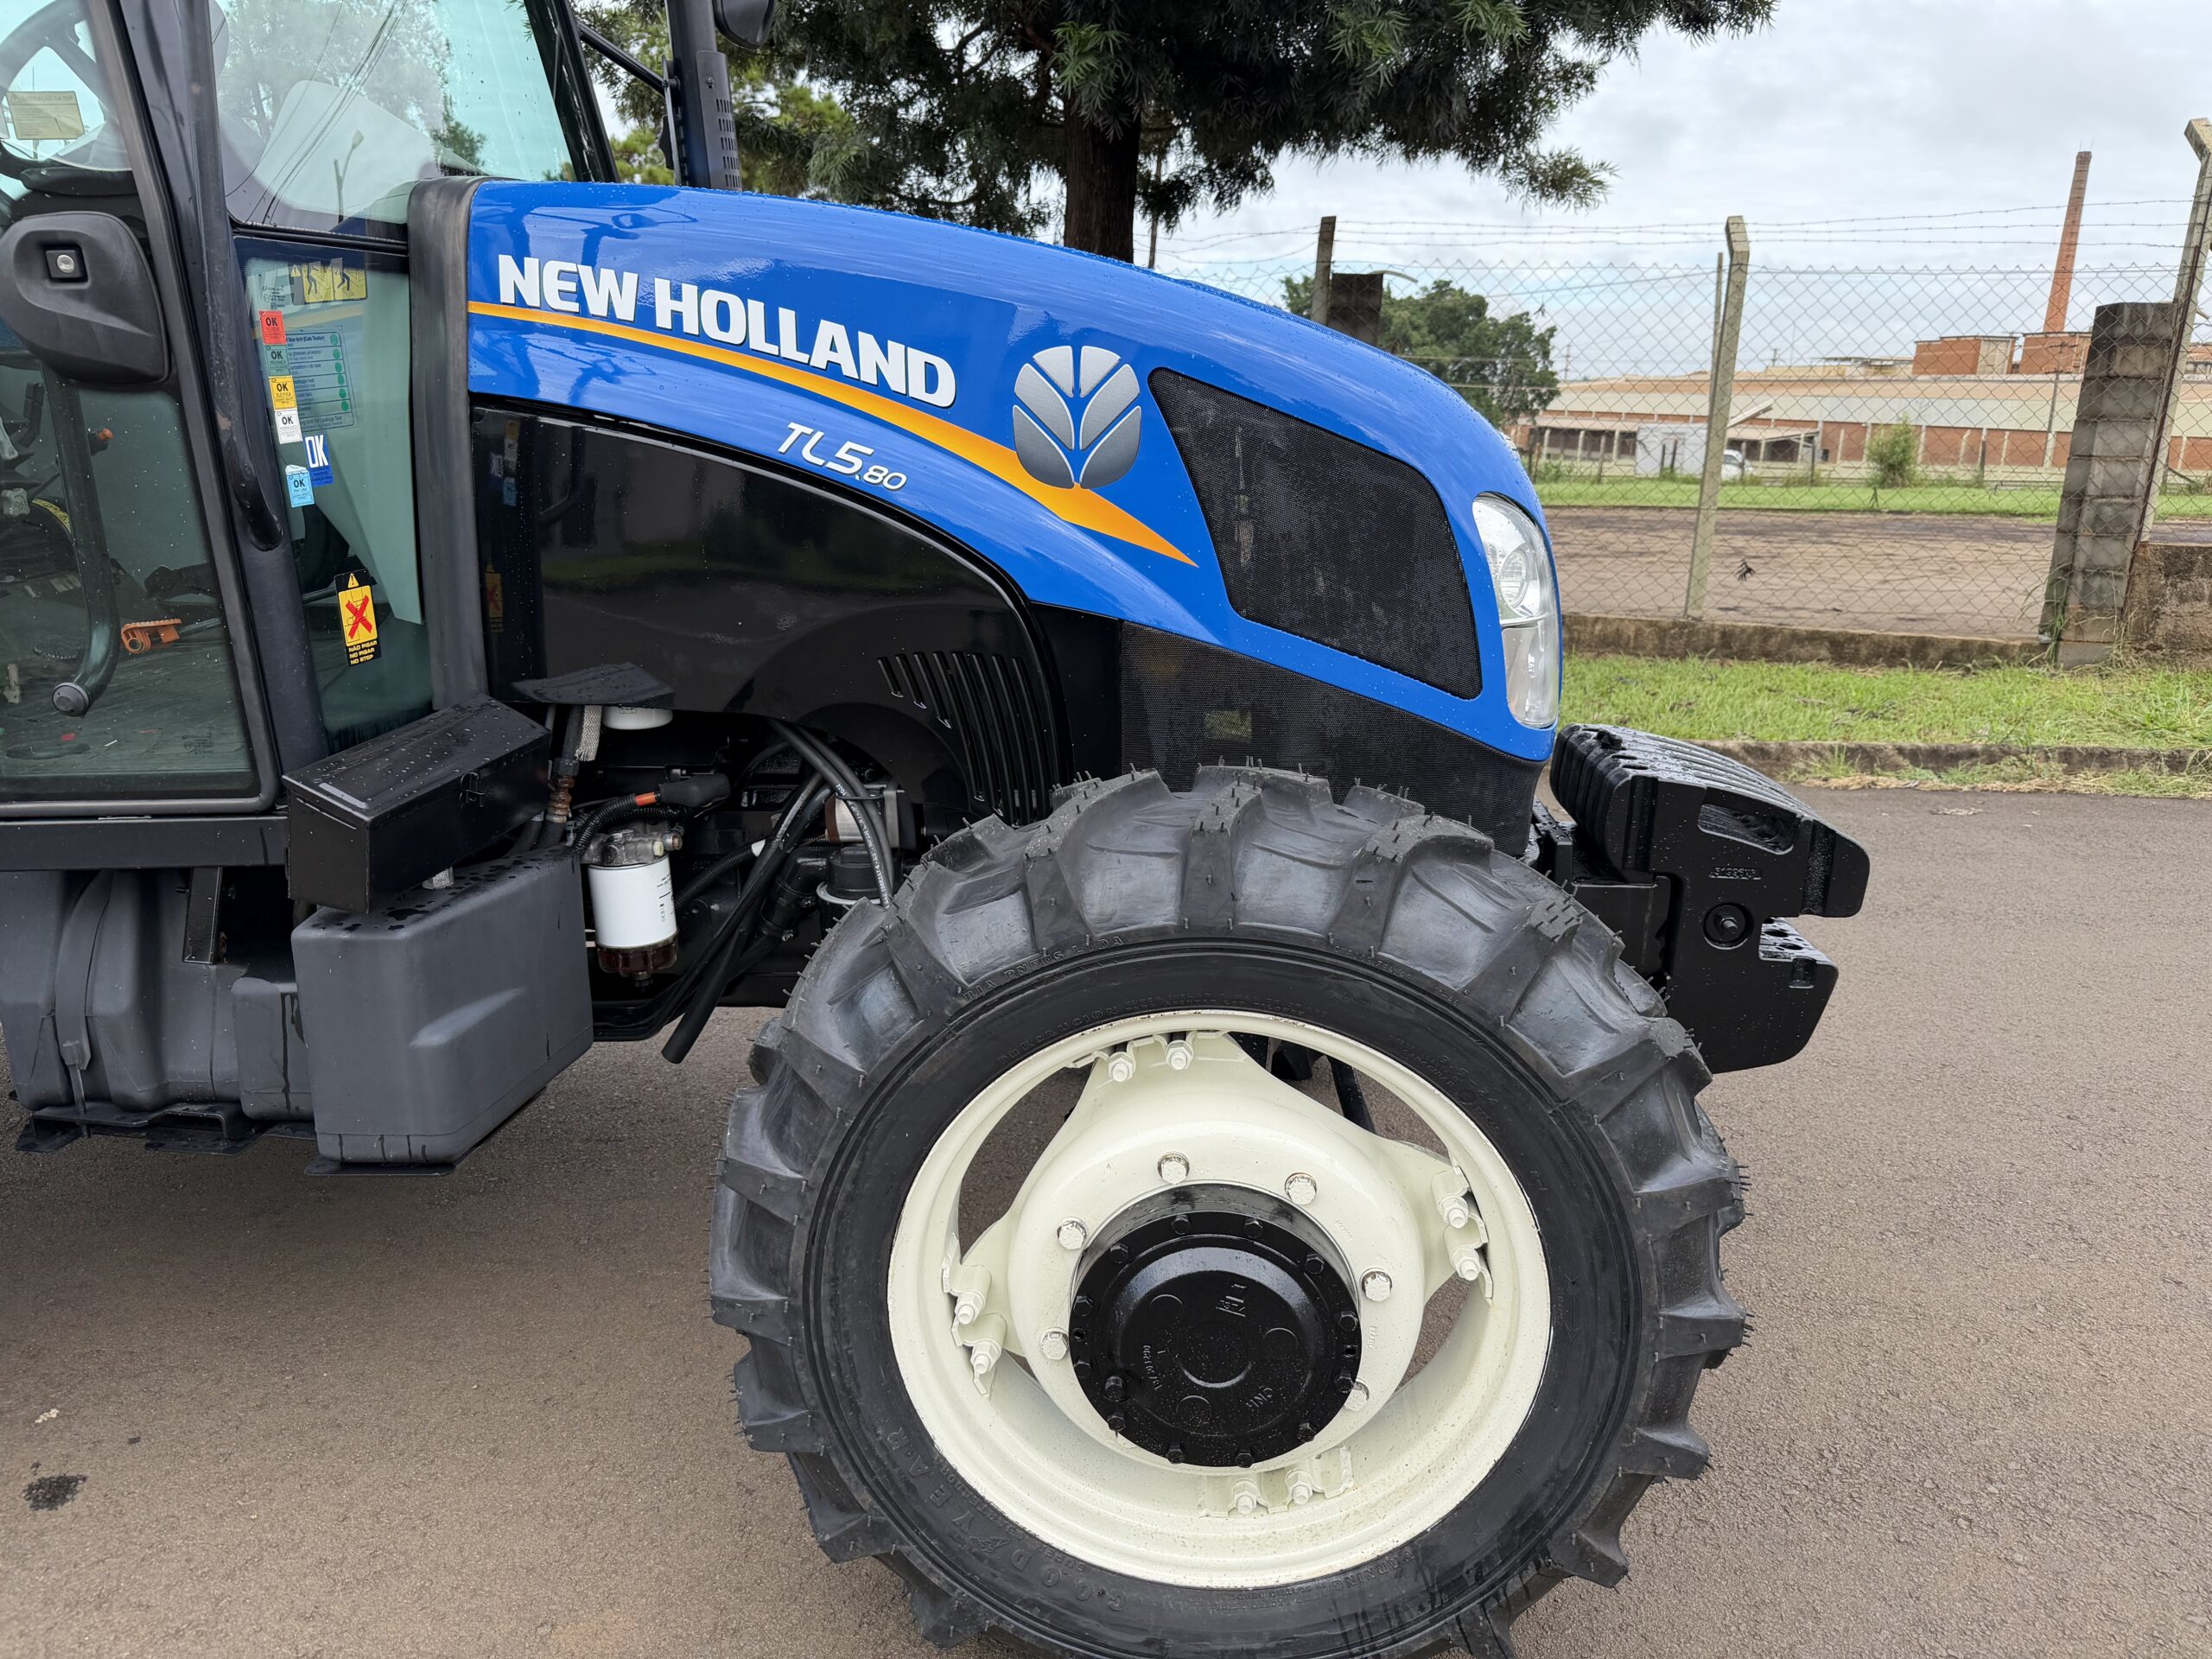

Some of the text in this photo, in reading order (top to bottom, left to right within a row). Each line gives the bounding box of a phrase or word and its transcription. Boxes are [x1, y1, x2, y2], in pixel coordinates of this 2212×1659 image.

[265, 317, 278, 327] OK
[499, 254, 957, 408] NEW HOLLAND
[270, 350, 283, 359] OK
[276, 383, 289, 391] OK
[282, 416, 294, 425] OK
[305, 435, 329, 468] OK
[778, 423, 907, 490] TL5.80
[293, 479, 306, 488] OK
[1003, 950, 1065, 981] PNEUS
[1071, 936, 1125, 956] LTDA
